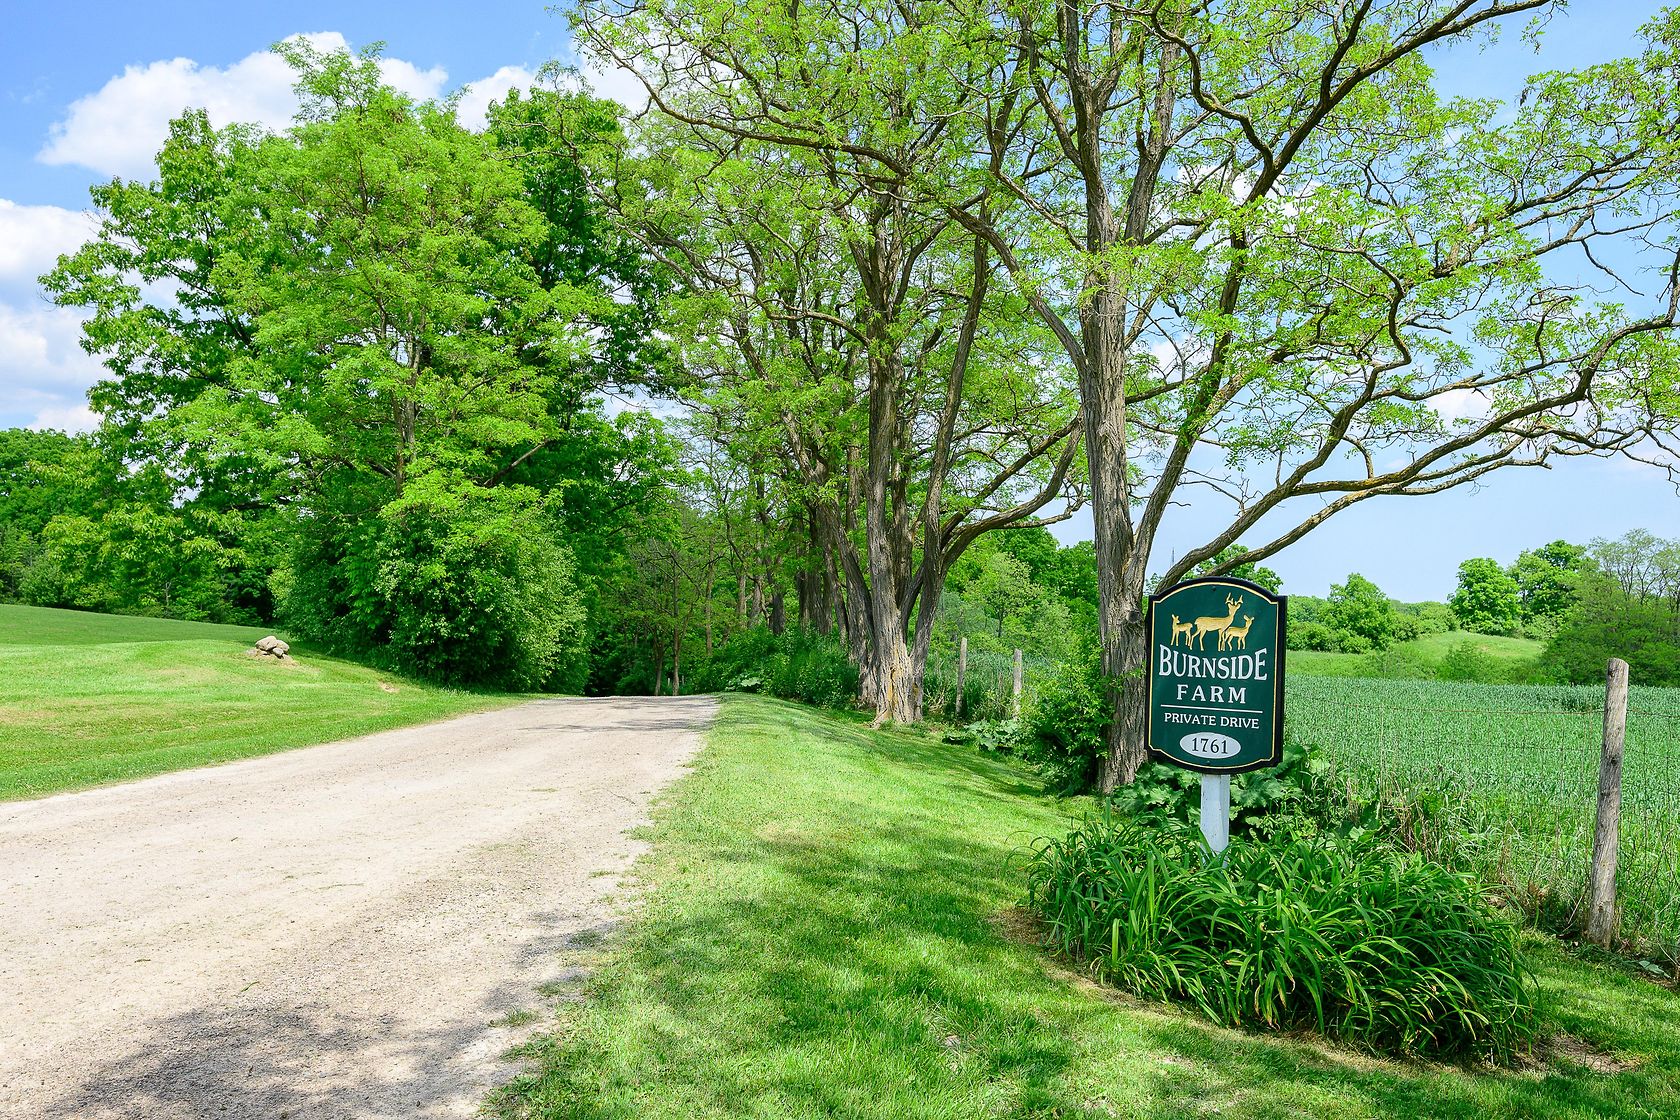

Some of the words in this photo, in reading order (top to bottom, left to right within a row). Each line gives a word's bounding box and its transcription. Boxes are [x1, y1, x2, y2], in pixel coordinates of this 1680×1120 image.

[1159, 644, 1268, 681] BURNSIDE
[1177, 684, 1247, 704] FARM
[1164, 712, 1217, 726] PRIVATE
[1220, 716, 1260, 729] DRIVE
[1191, 737, 1229, 754] 1761
